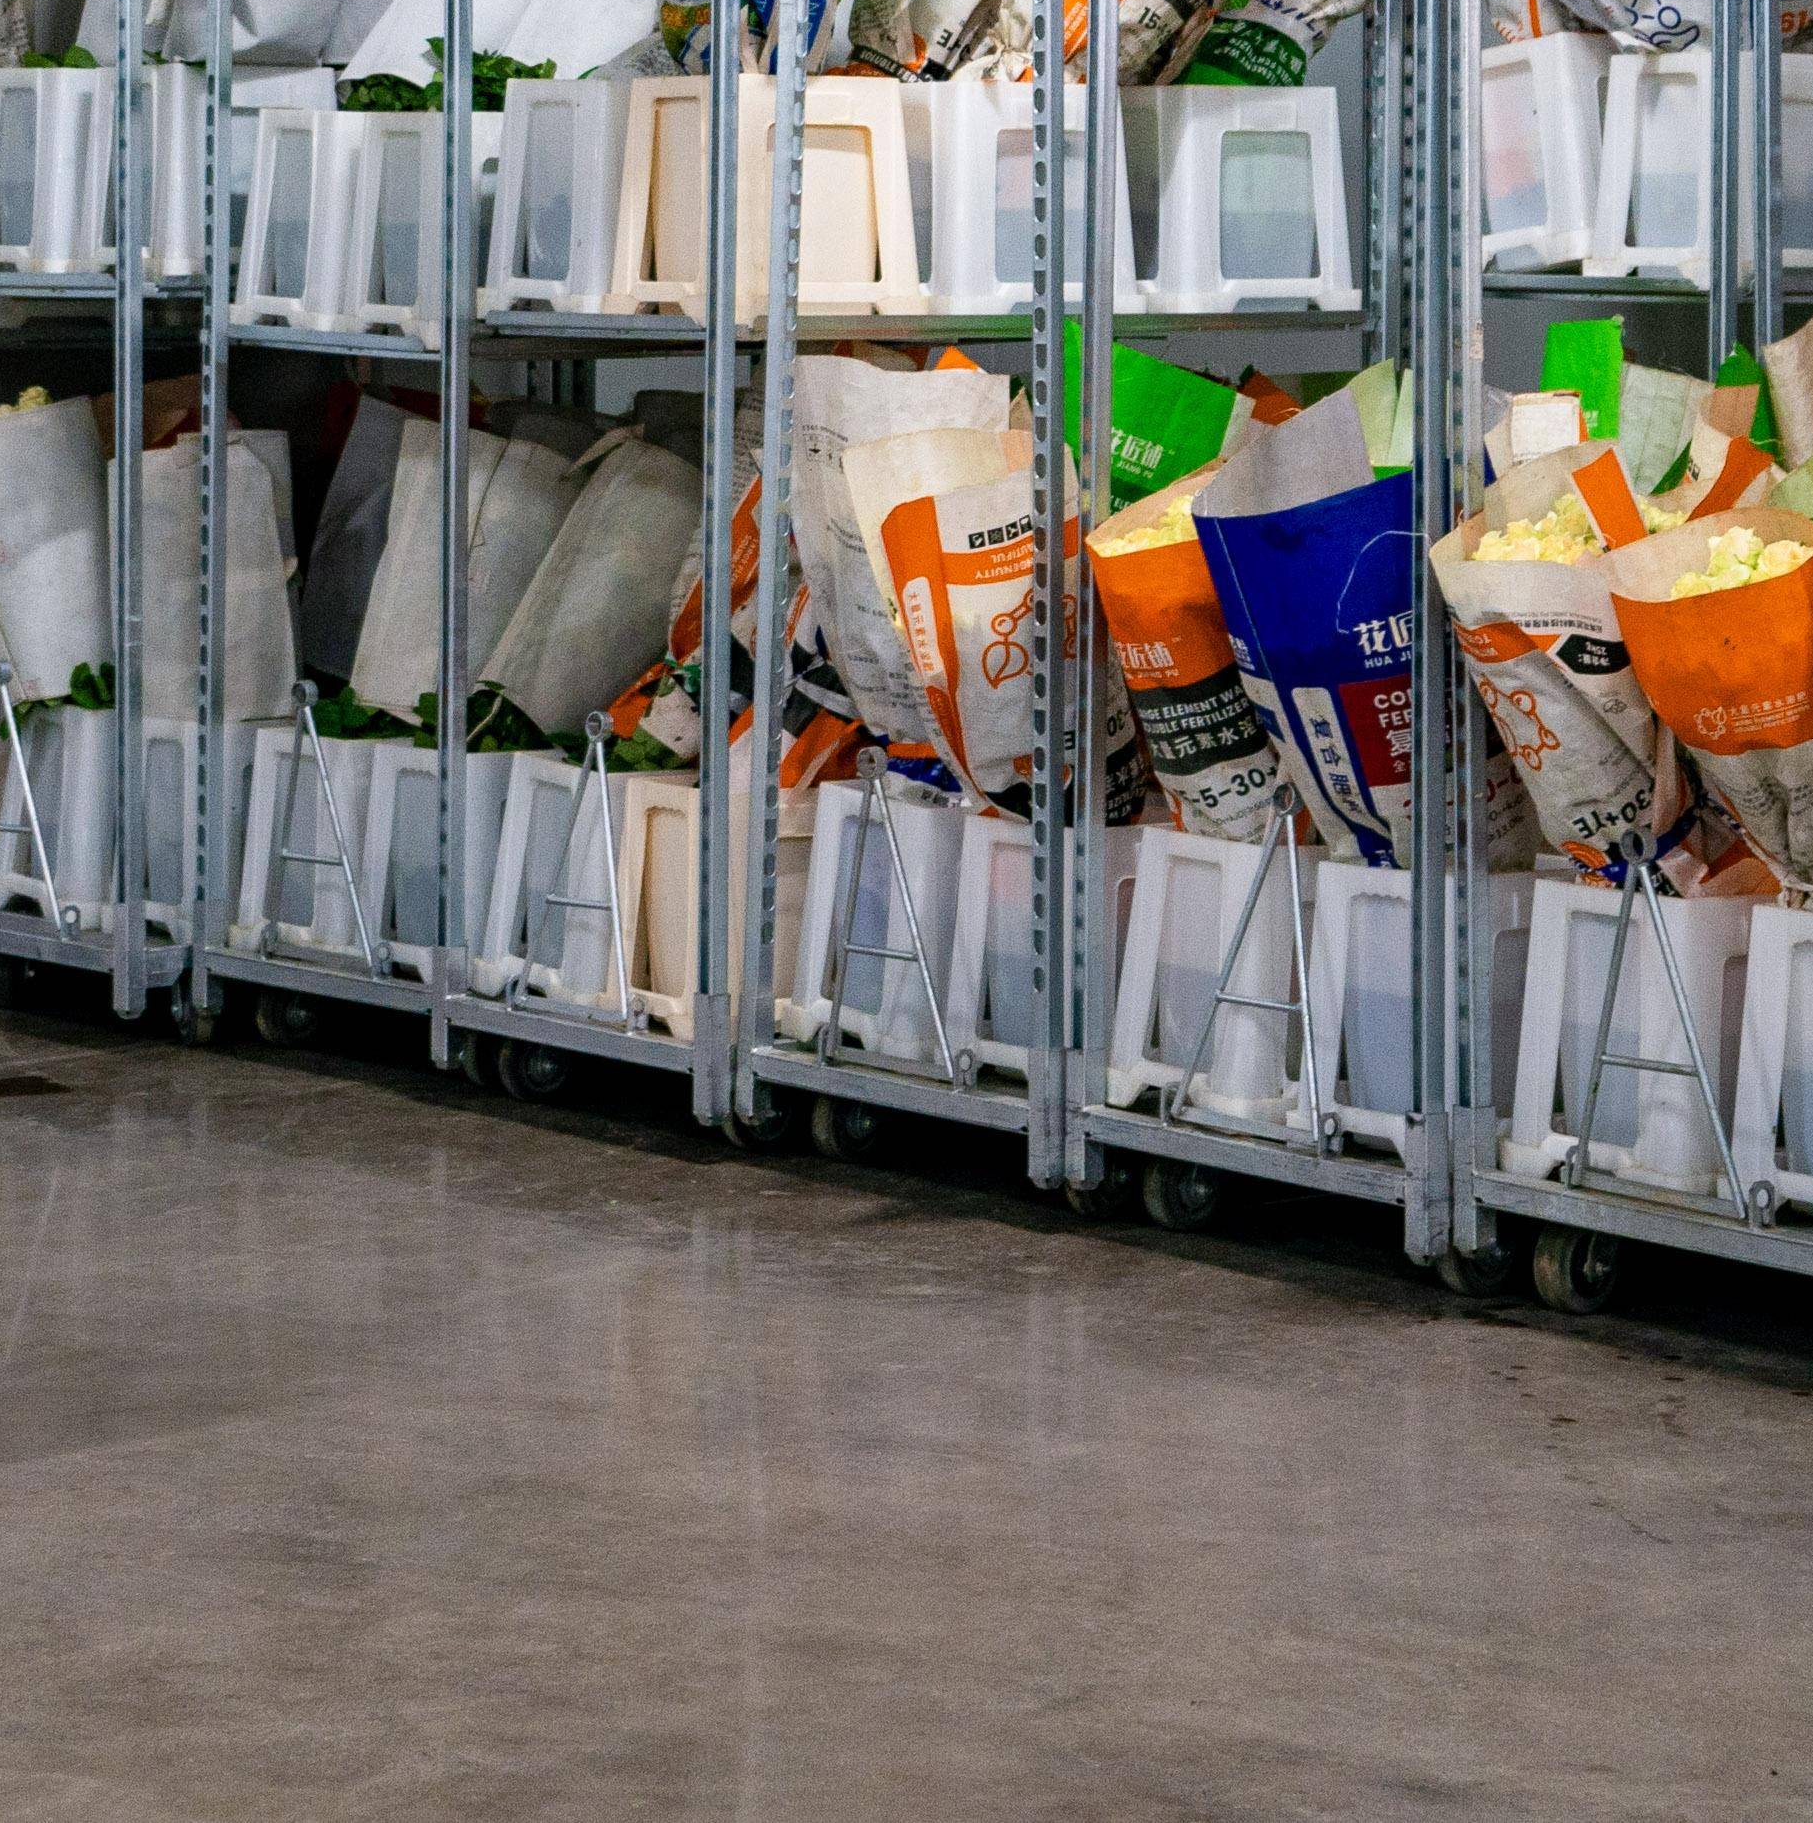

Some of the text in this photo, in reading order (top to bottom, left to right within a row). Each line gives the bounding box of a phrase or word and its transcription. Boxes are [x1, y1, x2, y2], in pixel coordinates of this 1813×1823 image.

[1353, 609, 1414, 657] 花匠
[1364, 655, 1393, 670] HUA
[1163, 695, 1220, 719] ELEMENT
[1180, 696, 1251, 730] FERTILIZER
